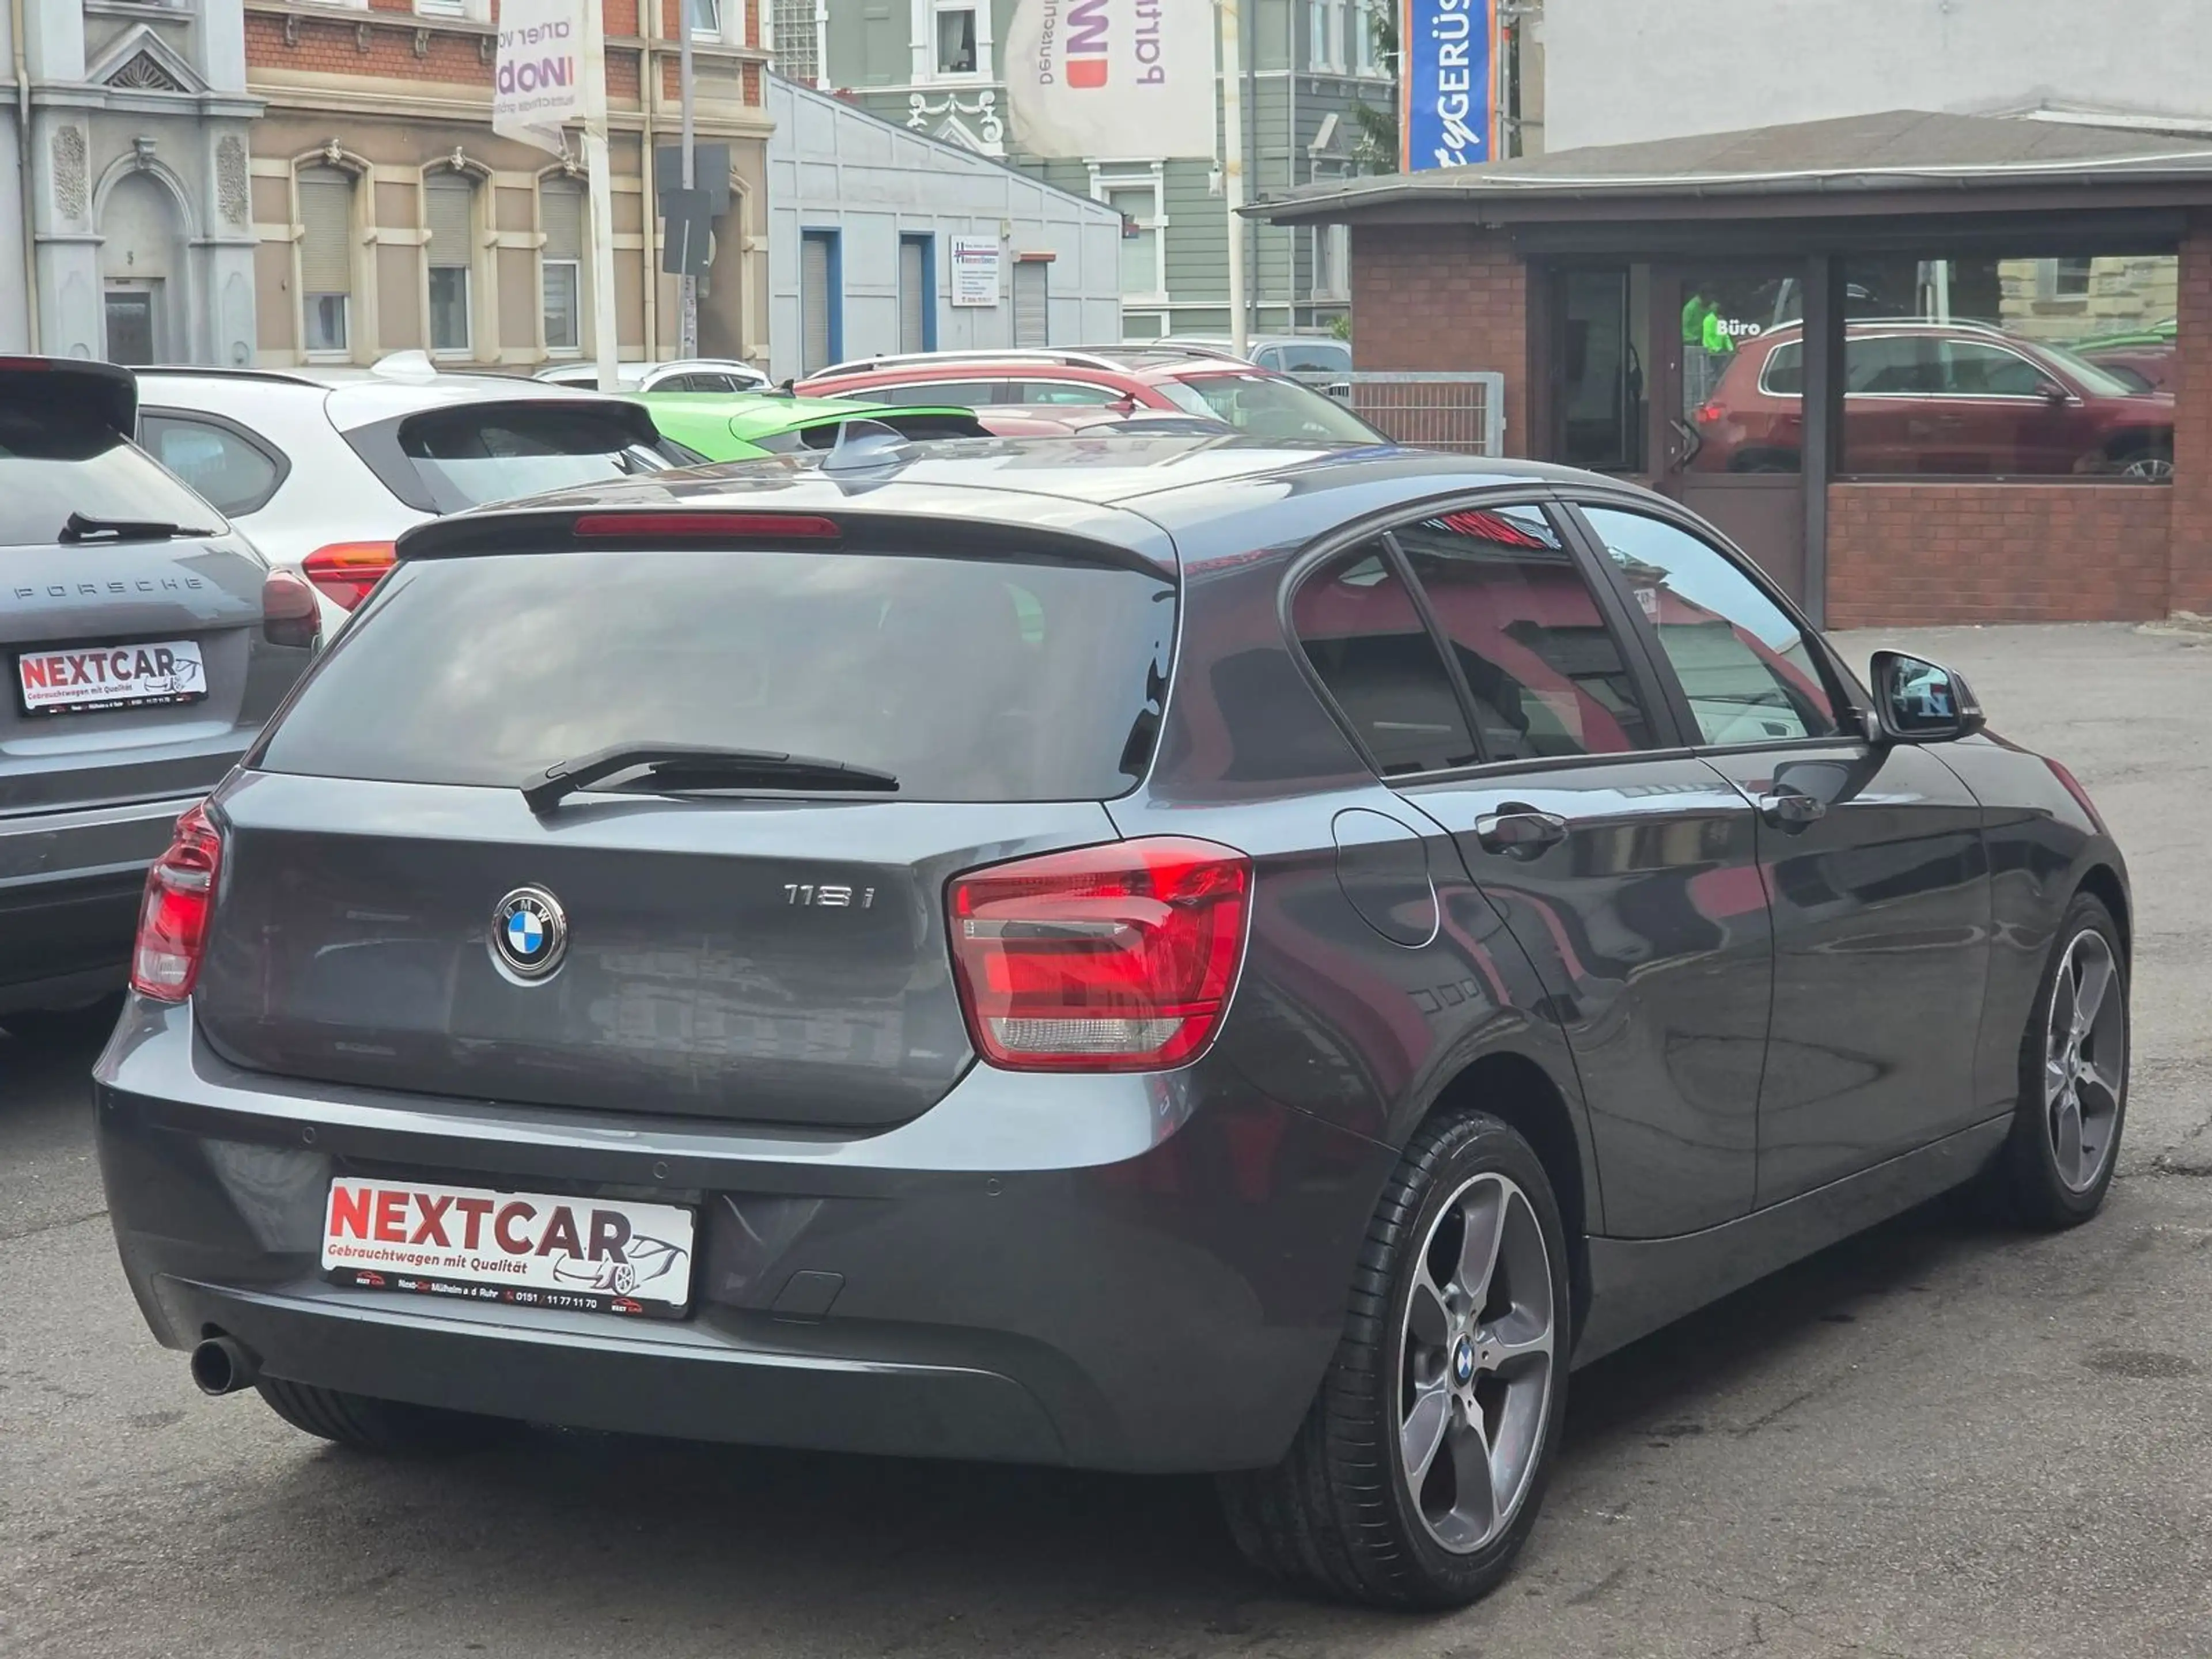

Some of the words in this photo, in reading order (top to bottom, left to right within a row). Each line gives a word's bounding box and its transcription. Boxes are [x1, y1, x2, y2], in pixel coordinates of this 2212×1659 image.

[1717, 319, 1760, 335] Büro
[14, 578, 203, 599] PORSCHE
[22, 648, 177, 689] NEXTCAR
[503, 900, 550, 923] BMW
[329, 1186, 631, 1264] NEXTCAR
[328, 1244, 440, 1266] Gebrauchtwagen
[444, 1255, 467, 1268] mit
[471, 1258, 528, 1274] Qualität
[516, 1292, 537, 1302] 0151
